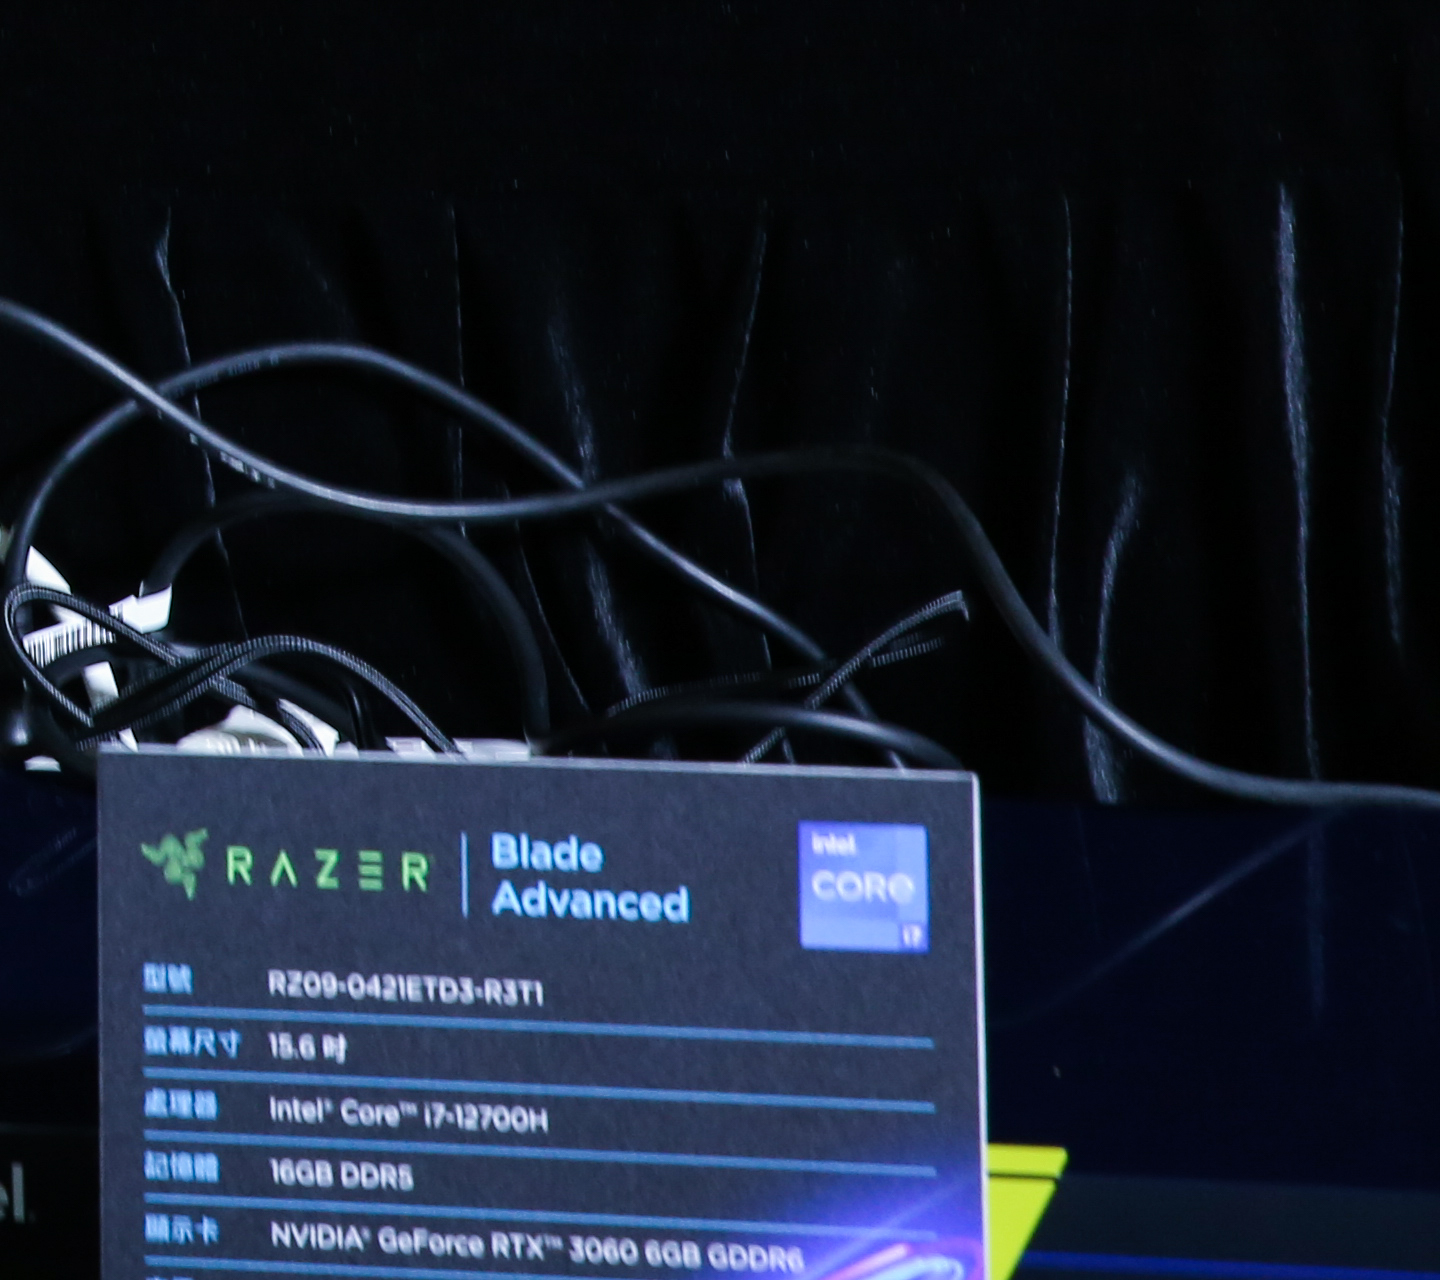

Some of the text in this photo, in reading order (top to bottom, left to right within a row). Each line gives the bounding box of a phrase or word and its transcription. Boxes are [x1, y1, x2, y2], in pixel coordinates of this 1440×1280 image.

[492, 833, 603, 873] Blade
[812, 831, 857, 856] intel
[226, 845, 431, 893] RAZER
[492, 879, 690, 923] Advanced
[268, 1030, 315, 1062] 15.6
[270, 1157, 413, 1192] 16GB DDR5
[378, 1223, 483, 1258] GeForce
